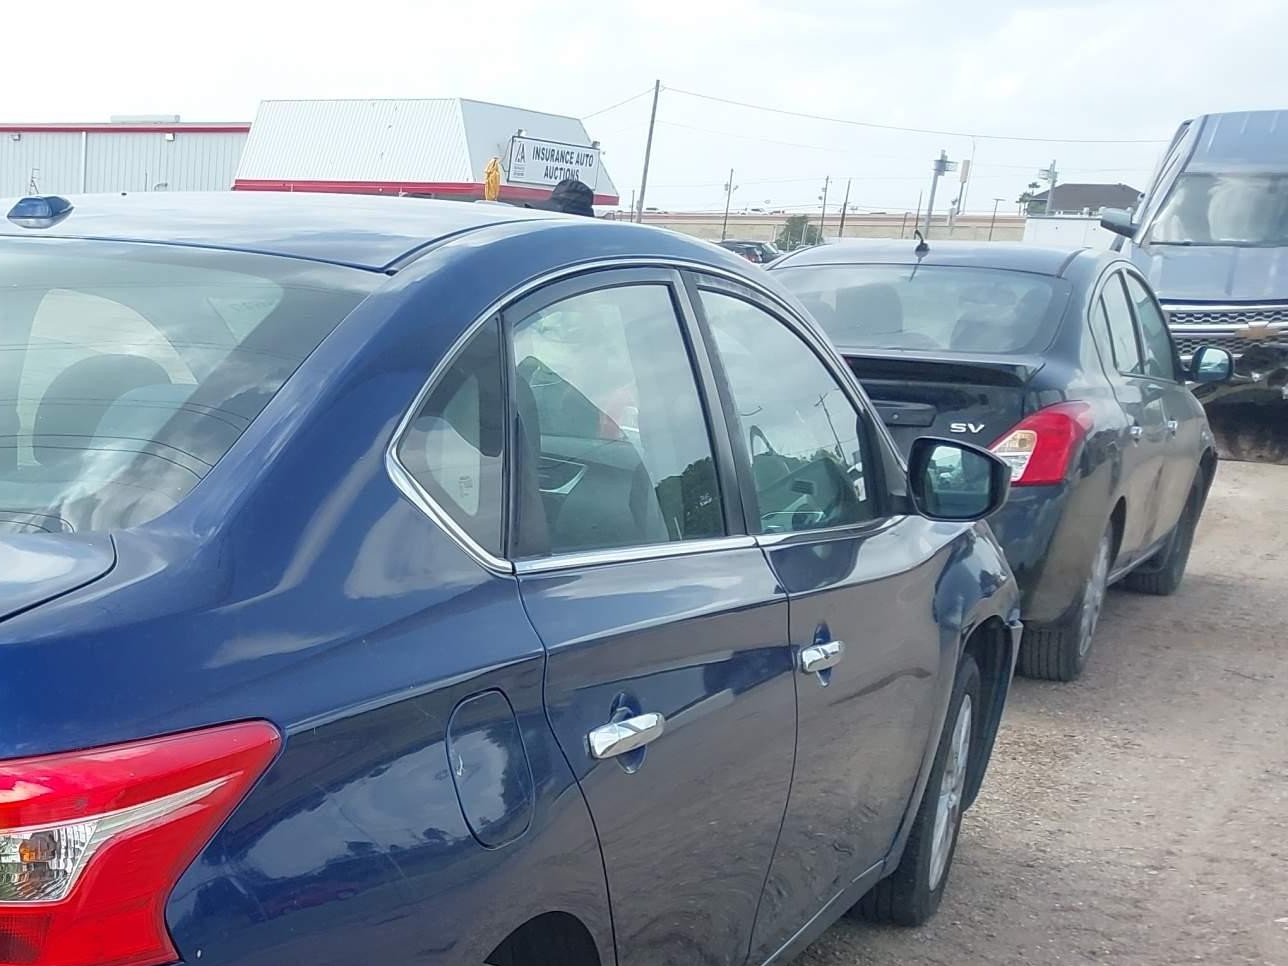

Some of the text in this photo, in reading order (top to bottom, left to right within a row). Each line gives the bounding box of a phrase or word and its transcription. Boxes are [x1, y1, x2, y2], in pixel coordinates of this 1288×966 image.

[532, 145, 594, 168] INSURANCE AUTO
[544, 165, 580, 181] AUCTIONS
[950, 422, 985, 433] SV
